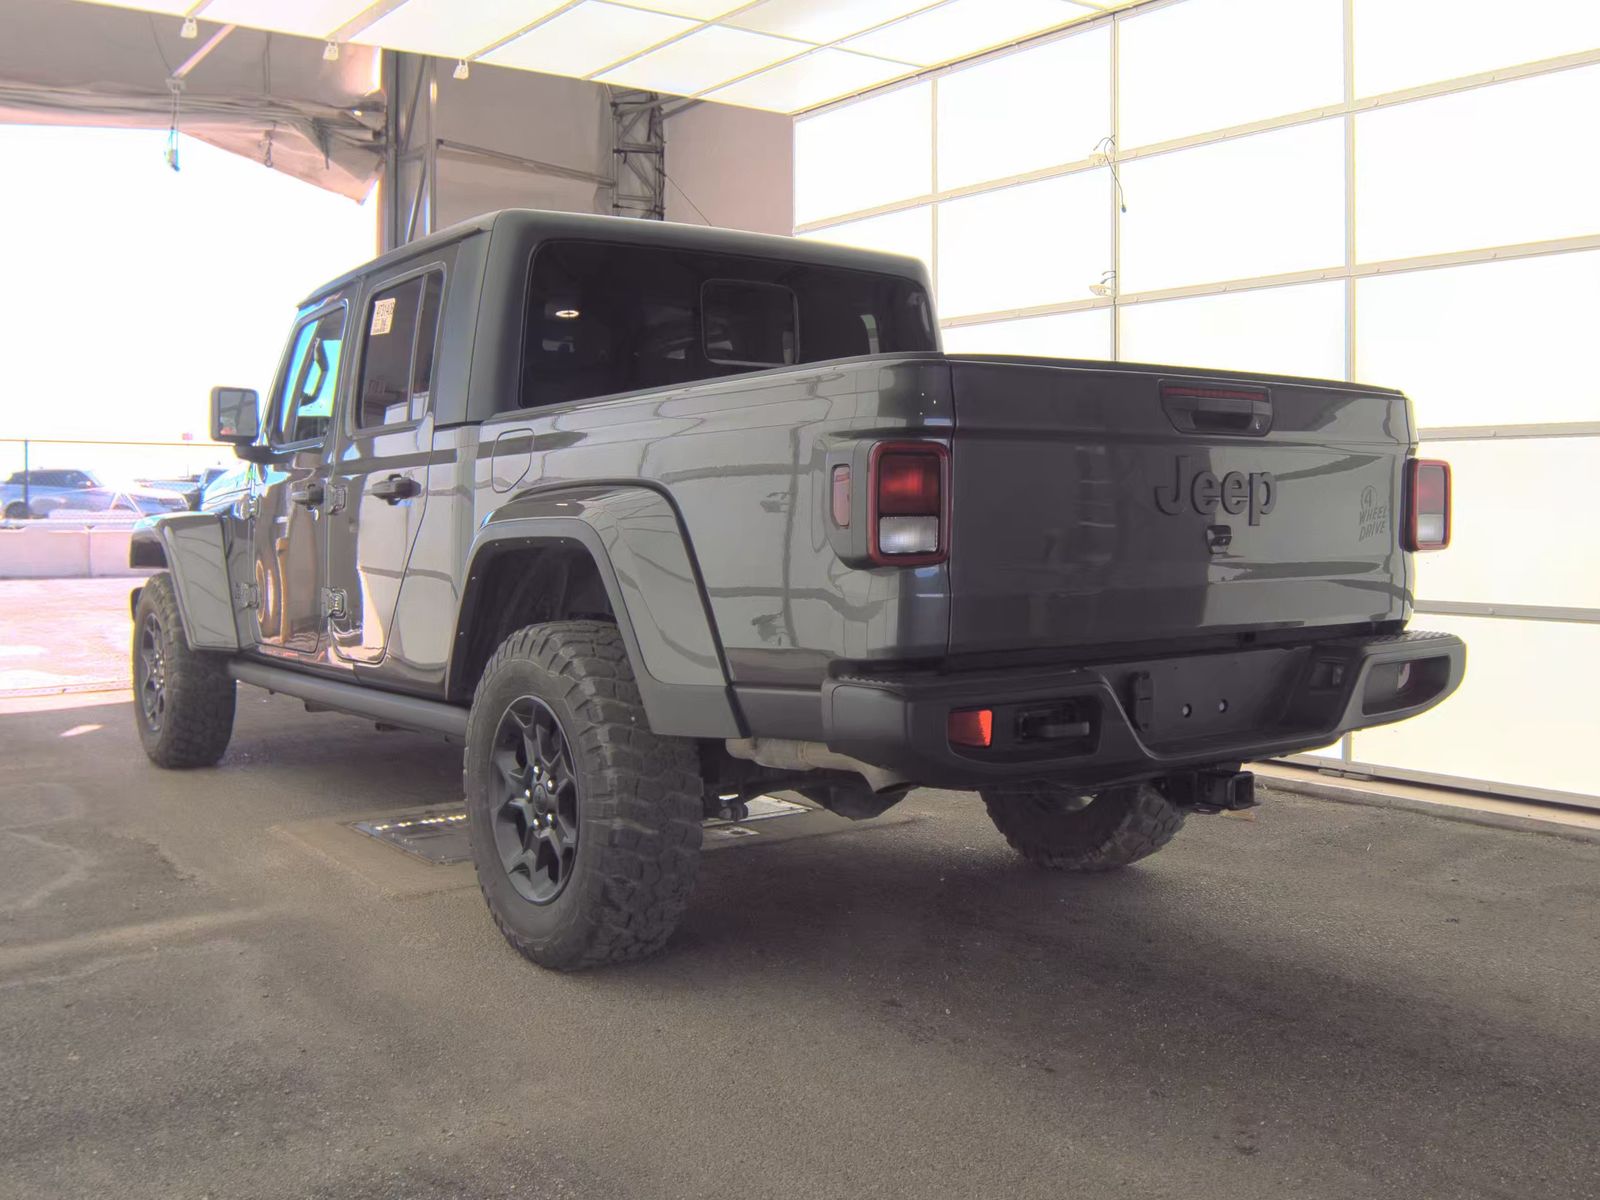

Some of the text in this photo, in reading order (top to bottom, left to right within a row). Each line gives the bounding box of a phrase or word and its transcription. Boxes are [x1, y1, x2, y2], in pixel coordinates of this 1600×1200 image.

[1155, 455, 1277, 527] Jeep
[1359, 505, 1387, 525] WHEEL
[1359, 520, 1385, 542] DRIVE
